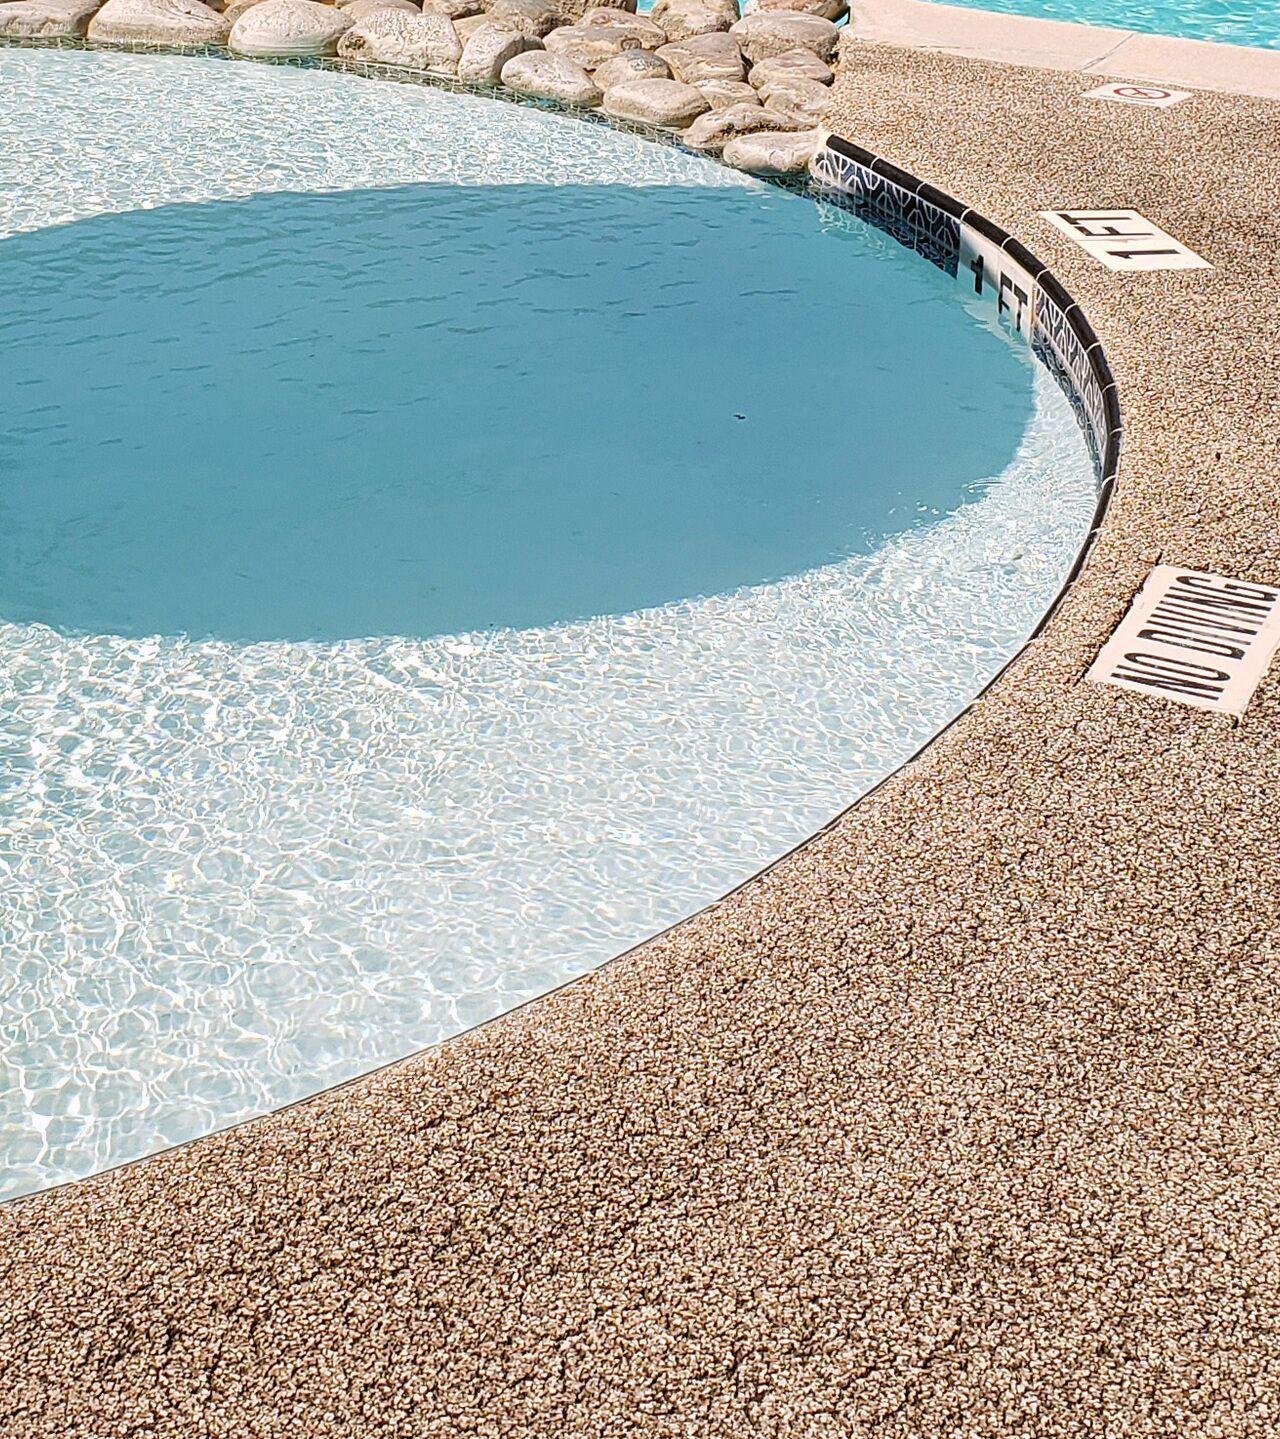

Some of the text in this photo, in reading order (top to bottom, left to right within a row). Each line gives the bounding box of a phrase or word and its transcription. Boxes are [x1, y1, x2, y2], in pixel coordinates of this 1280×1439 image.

[1058, 213, 1181, 259] 1 FT
[971, 254, 1028, 332] 1 FT
[1111, 575, 1278, 701] NO DIVING
